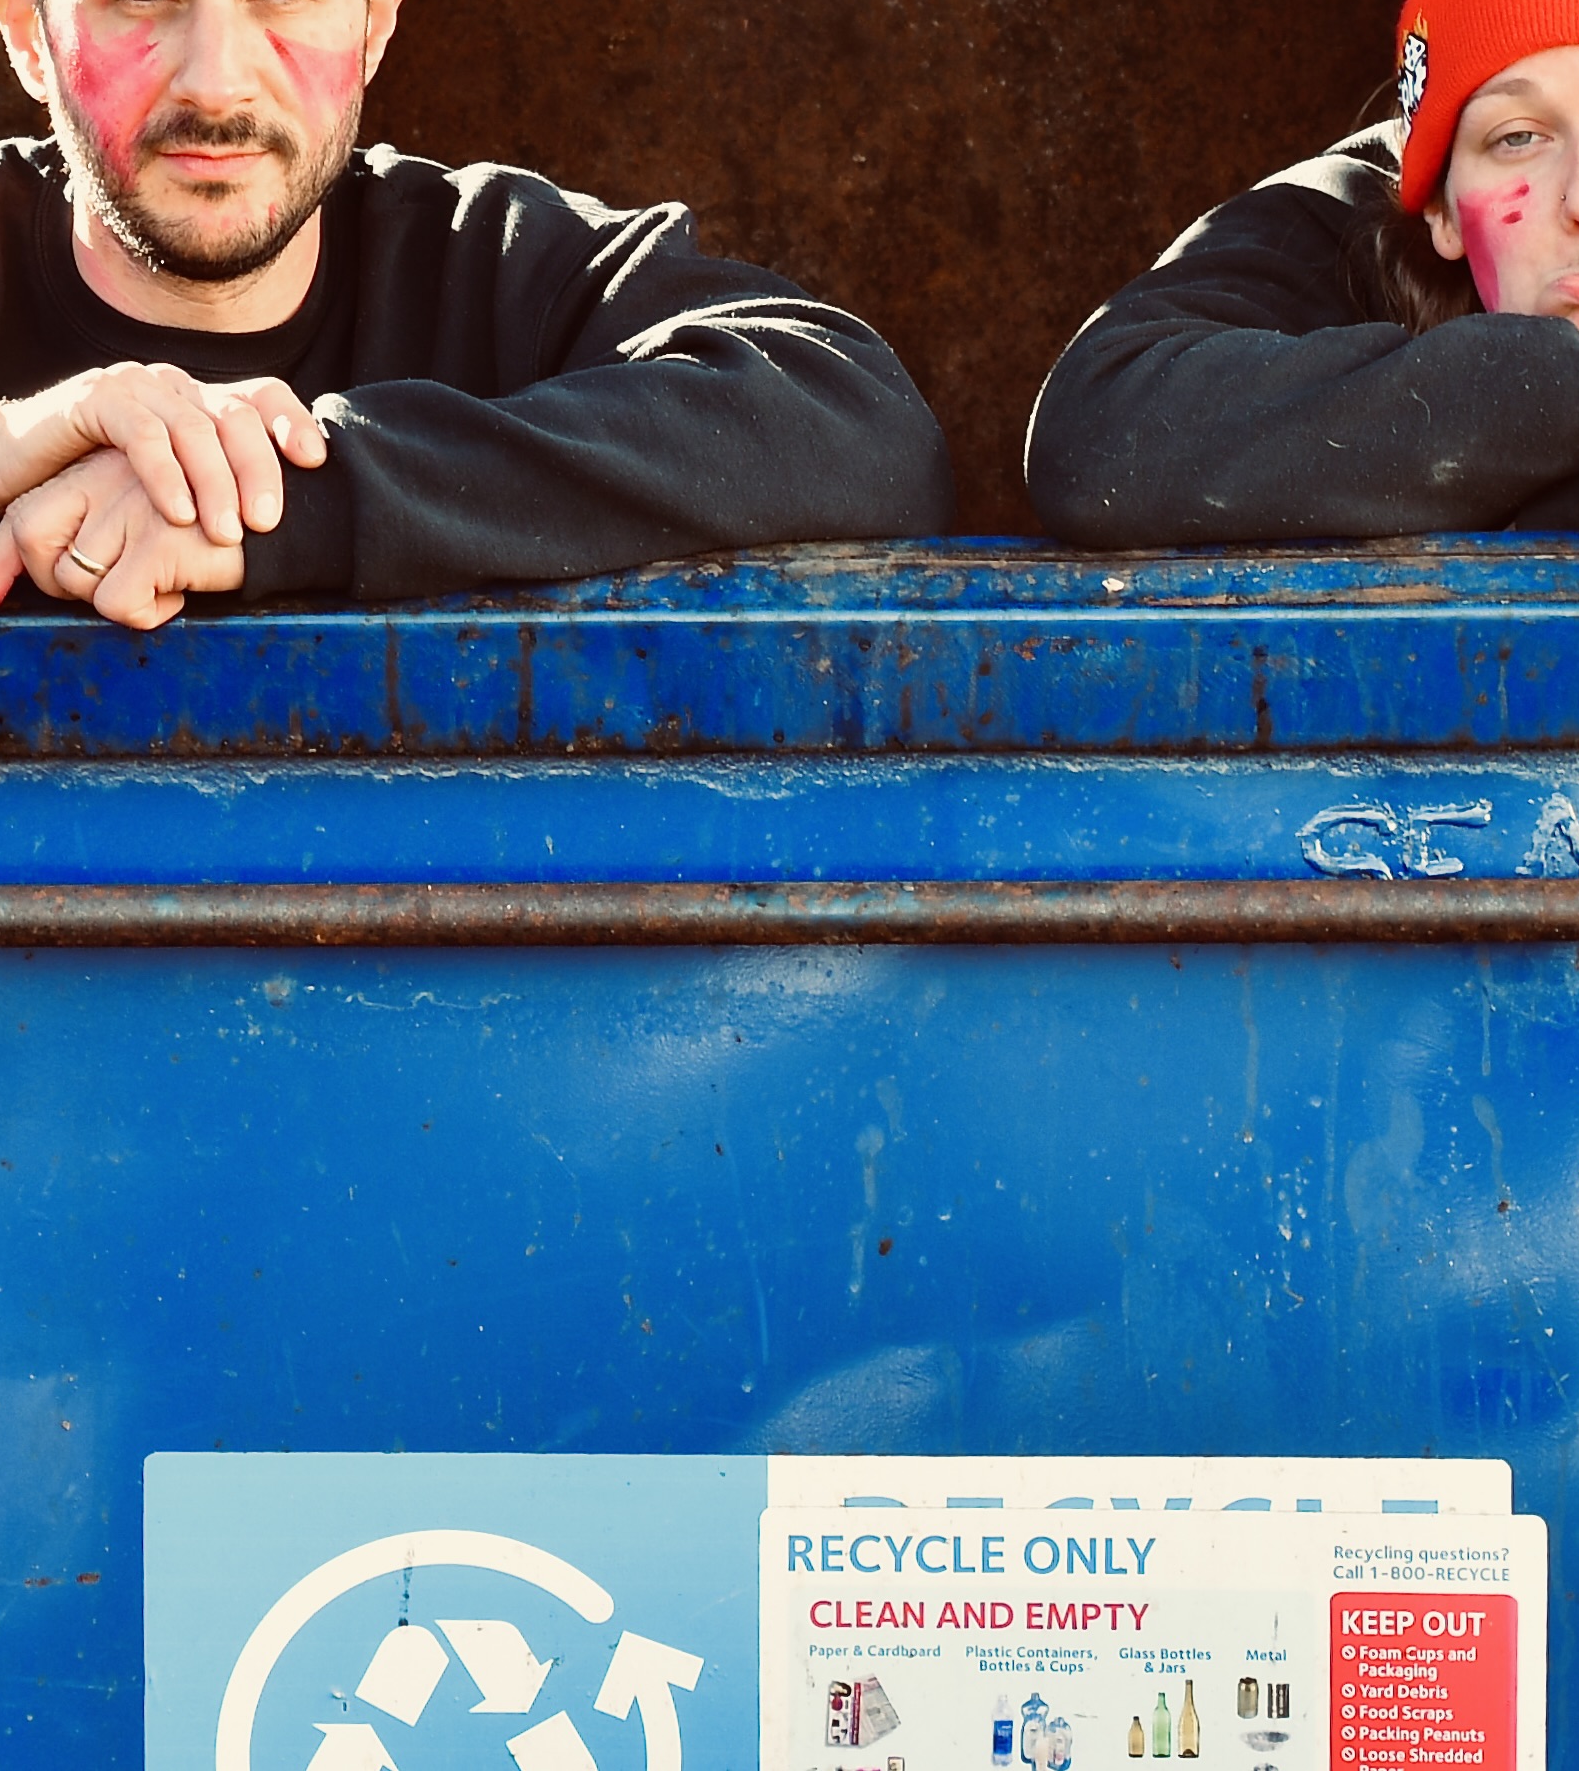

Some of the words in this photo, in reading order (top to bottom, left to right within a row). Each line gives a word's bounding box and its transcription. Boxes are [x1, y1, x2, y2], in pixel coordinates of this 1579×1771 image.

[787, 1534, 1005, 1574] RECYCLE
[1023, 1535, 1156, 1575] ONLY
[1334, 1545, 1413, 1564] Recycling
[1418, 1547, 1509, 1564] questions?
[1333, 1565, 1364, 1579] Call
[1370, 1566, 1510, 1581] 1-800-RECYCLE
[809, 1600, 925, 1629] CLEAN
[936, 1601, 1014, 1629] AND
[1026, 1602, 1149, 1631] EMPTY
[1341, 1610, 1415, 1636] KEEP
[1422, 1610, 1486, 1637] OUT
[809, 1645, 849, 1659] Paper
[853, 1645, 863, 1657] &
[867, 1645, 941, 1658] Cardboard
[965, 1645, 1012, 1659] Plastic
[1016, 1646, 1098, 1661] Containers,
[1118, 1647, 1156, 1660] Glass
[1160, 1647, 1212, 1660] Bottles
[1245, 1649, 1287, 1661] Metal
[1359, 1645, 1402, 1660] Foam
[1405, 1646, 1444, 1664] Cups
[1447, 1647, 1477, 1661] and
[979, 1660, 1030, 1672] Bottles
[1034, 1660, 1045, 1672] &
[1049, 1660, 1084, 1675] Cups
[1144, 1662, 1154, 1673] &
[1158, 1662, 1186, 1674] Jars
[1358, 1663, 1438, 1682] Packaging
[1359, 1684, 1394, 1699] Yard
[1397, 1684, 1449, 1699] Debris
[1359, 1705, 1399, 1719] Food
[1401, 1706, 1453, 1724] Scraps
[1359, 1726, 1420, 1745] Packing
[1423, 1727, 1485, 1742] Peanuts
[1359, 1747, 1405, 1762] Loose
[1409, 1747, 1483, 1763] Shredded
